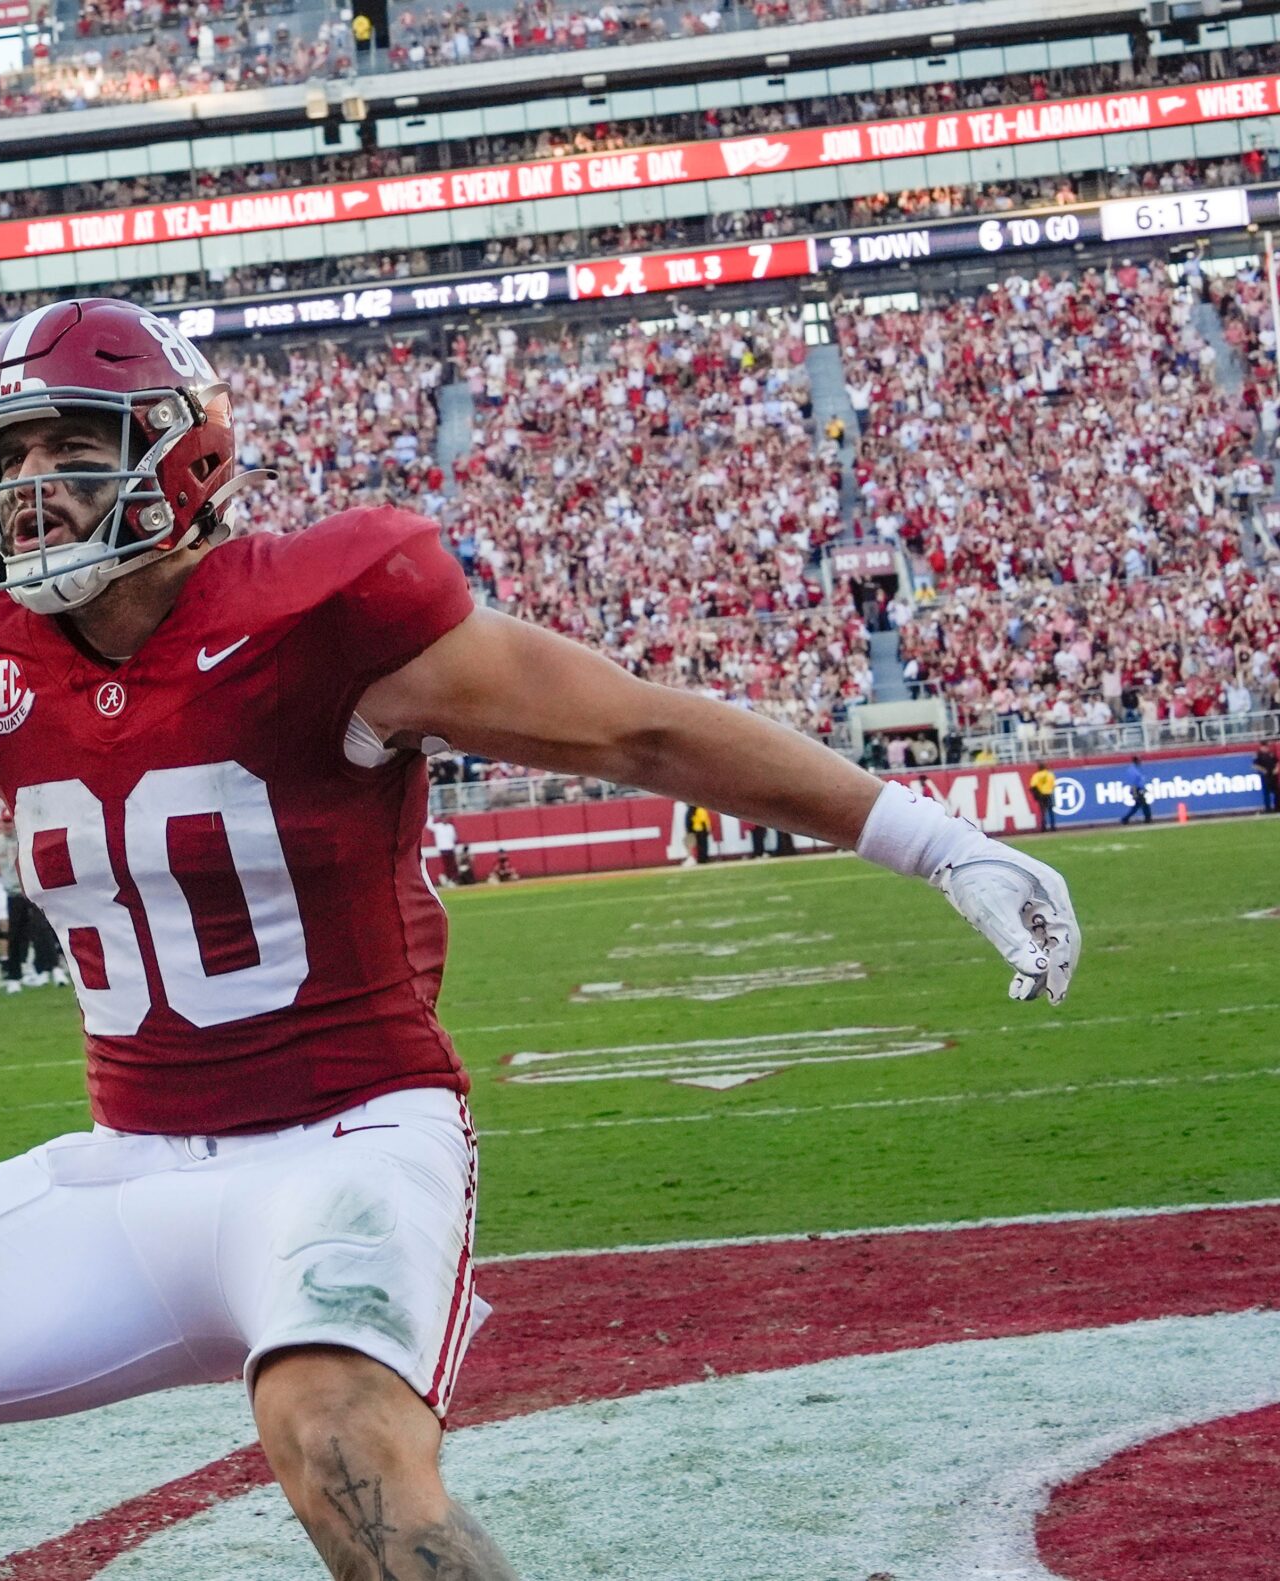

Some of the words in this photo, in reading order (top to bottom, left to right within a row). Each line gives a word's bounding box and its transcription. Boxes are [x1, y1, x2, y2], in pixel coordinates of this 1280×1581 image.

[819, 129, 862, 161] JOIN
[867, 122, 926, 155] TODAY
[936, 118, 958, 148] AT
[968, 96, 1151, 145] YEA-ALABAMA.COM
[1196, 82, 1269, 117] WHERE
[25, 221, 65, 252] JOIN
[69, 214, 125, 247] TODAY
[133, 210, 155, 240] AT
[162, 190, 336, 236] YEA-ALABAMA.COM
[377, 178, 447, 212] WHERE
[451, 169, 510, 205] EVERY
[518, 165, 554, 197] DAY
[561, 161, 582, 192] IS
[588, 154, 641, 188] GAME
[647, 150, 688, 182] DAY.
[1135, 199, 1212, 230] 6:13
[703, 255, 723, 280] 3
[748, 244, 773, 278] 7
[830, 237, 853, 267] 3
[859, 230, 931, 263] DOWN
[979, 220, 1004, 251] 6
[1006, 219, 1039, 246] TO
[1045, 215, 1080, 242] GO
[244, 304, 295, 328] PASS
[341, 288, 393, 320] 142
[411, 287, 451, 309] TOT
[498, 271, 549, 303] 170
[140, 316, 218, 381] 80
[101, 687, 120, 710] A
[1054, 785, 1076, 810] H
[14, 760, 310, 1036] 80
